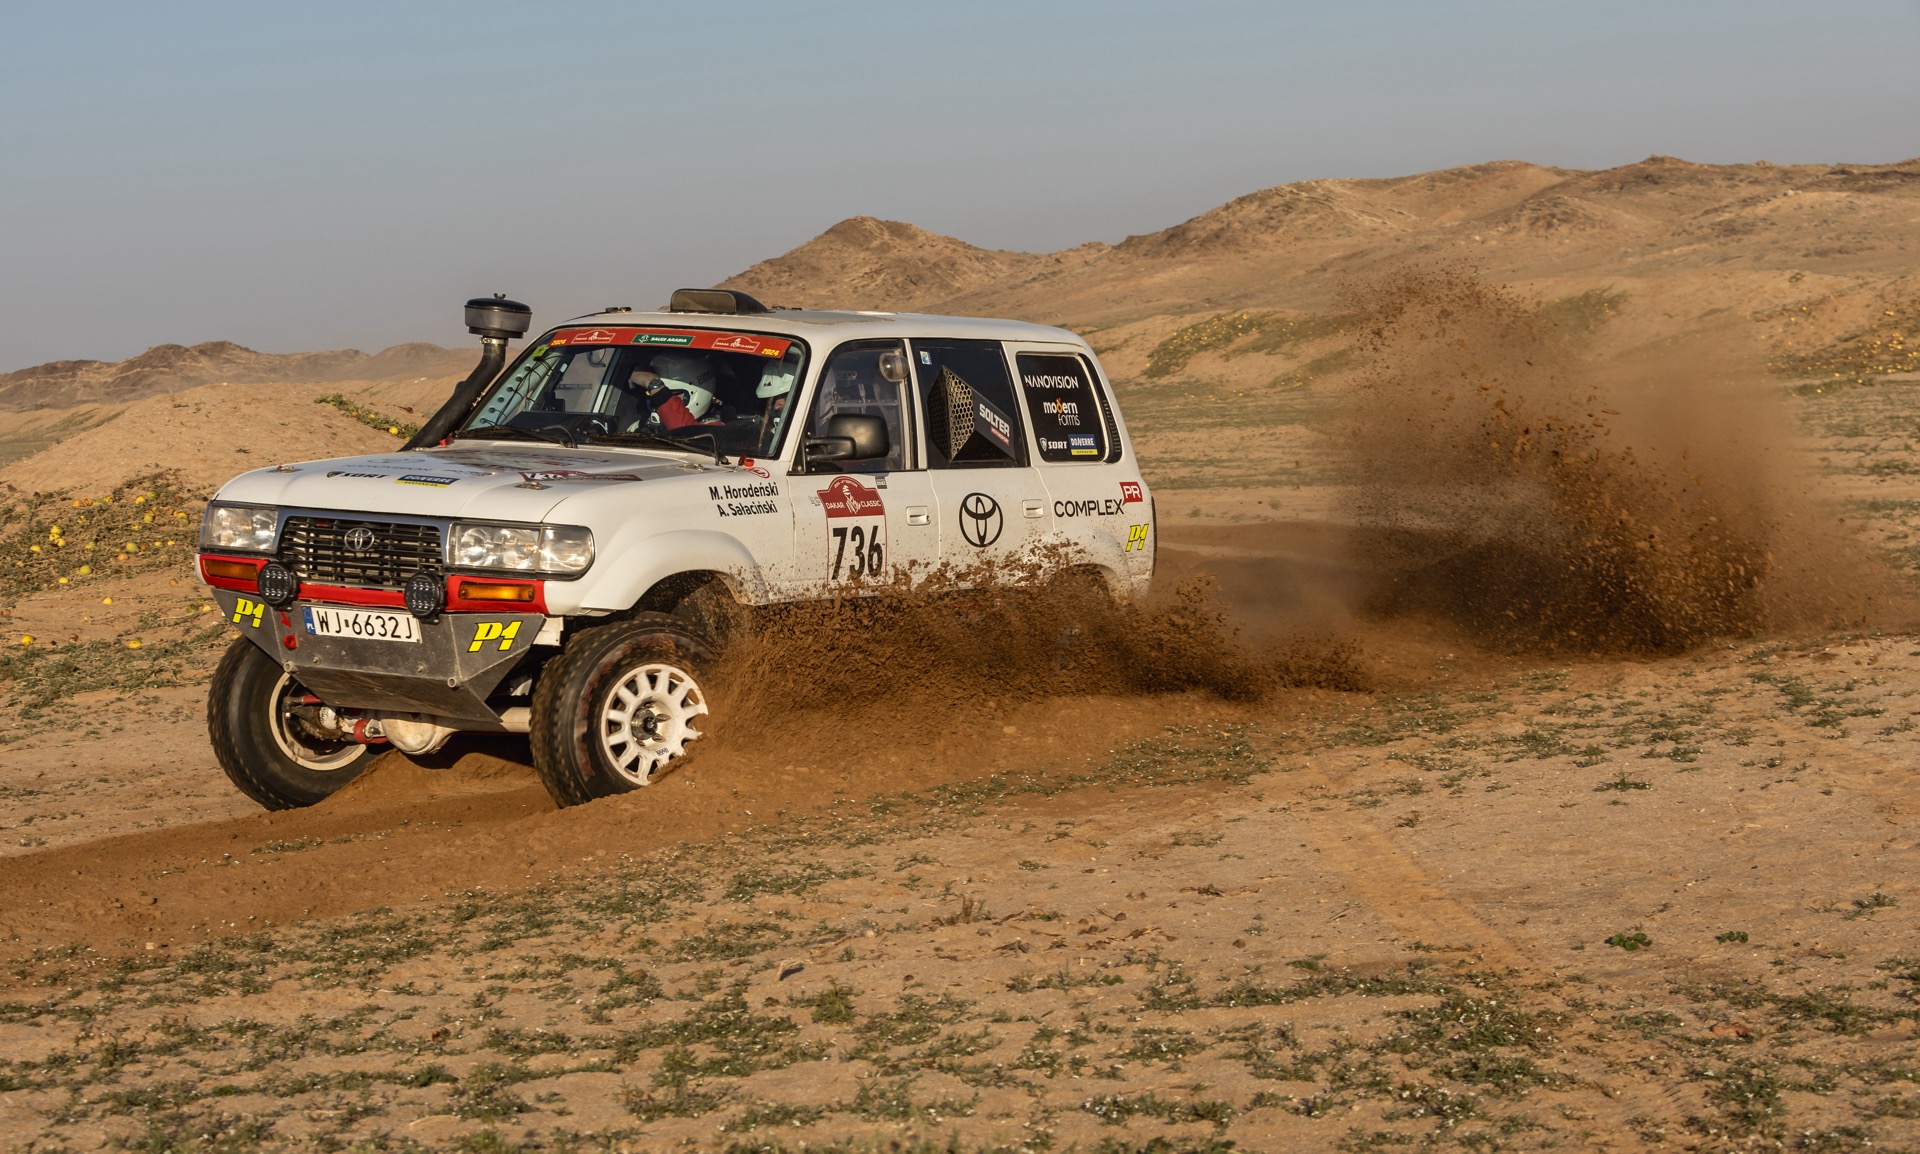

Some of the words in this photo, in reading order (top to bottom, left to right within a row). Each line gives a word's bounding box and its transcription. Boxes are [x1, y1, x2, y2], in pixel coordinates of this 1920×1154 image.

[761, 348, 780, 357] 2024
[1023, 374, 1079, 389] NANOVISION
[1043, 398, 1079, 414] modern
[979, 403, 1010, 438] SOLTER
[1047, 440, 1068, 450] SORT
[709, 486, 723, 501] M.
[723, 481, 780, 500] Horodeński
[1122, 485, 1141, 499] PR
[717, 504, 730, 518] A.
[728, 499, 779, 517] Sałaciński
[825, 501, 846, 510] DAKAR
[860, 499, 882, 508] CLASSIC
[1053, 499, 1125, 518] COMPLEX
[1125, 523, 1150, 553] P1
[831, 525, 884, 581] 736
[231, 597, 266, 629] P1
[316, 610, 342, 634] WJ
[351, 613, 413, 640] 6632J
[466, 620, 522, 653] P1
